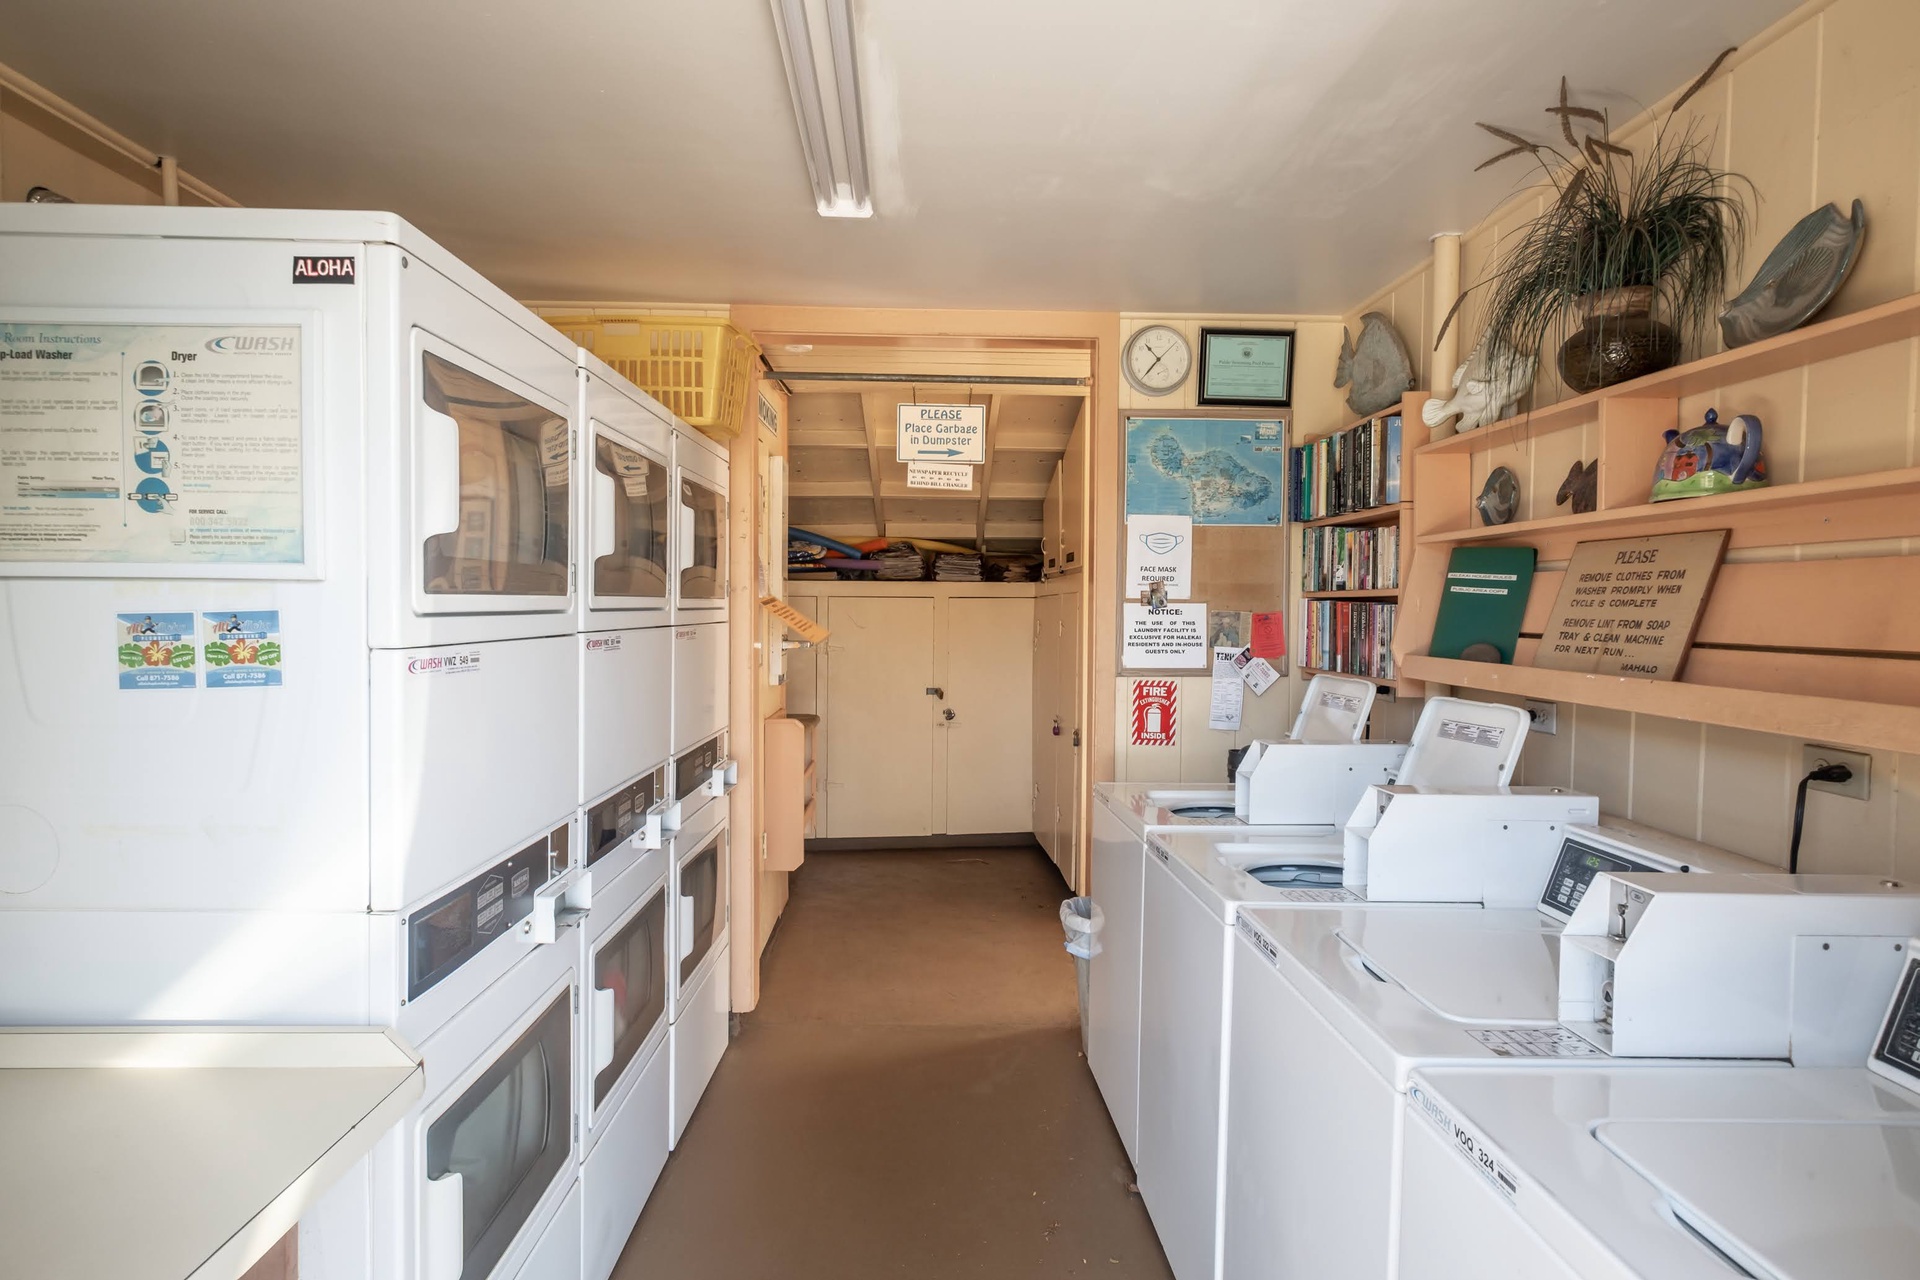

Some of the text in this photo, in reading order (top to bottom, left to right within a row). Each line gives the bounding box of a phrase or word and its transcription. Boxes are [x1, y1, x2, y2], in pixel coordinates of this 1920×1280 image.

[295, 259, 354, 276] ALOHA
[4, 332, 102, 344] Room Instructions
[234, 336, 294, 351] WASH
[36, 350, 73, 360] Washer
[171, 351, 198, 363] Dryer
[920, 409, 962, 420] PLEASE
[905, 423, 978, 434] Place Garbage
[910, 435, 972, 446] in Dumpster
[1615, 549, 1659, 565] PLEASE
[1579, 569, 1687, 583] REMOVE CLOTHES FROM
[1575, 585, 1682, 595] WASHER PROMPLY WHEN
[1570, 599, 1657, 608] CYCLE IS COMPLETE
[1563, 618, 1671, 630] REMOVE LINT FROM SOAP
[1558, 631, 1664, 645] TRAY & CLEAN MACHINE
[1554, 645, 1570, 653] FOR
[1574, 646, 1597, 655] NEXT
[420, 657, 443, 669] WASH
[444, 656, 457, 666] VWZ
[1620, 663, 1658, 674] MAHALO
[1143, 686, 1168, 696] FIRE
[1422, 1096, 1495, 1172] WASH VOQ 324
